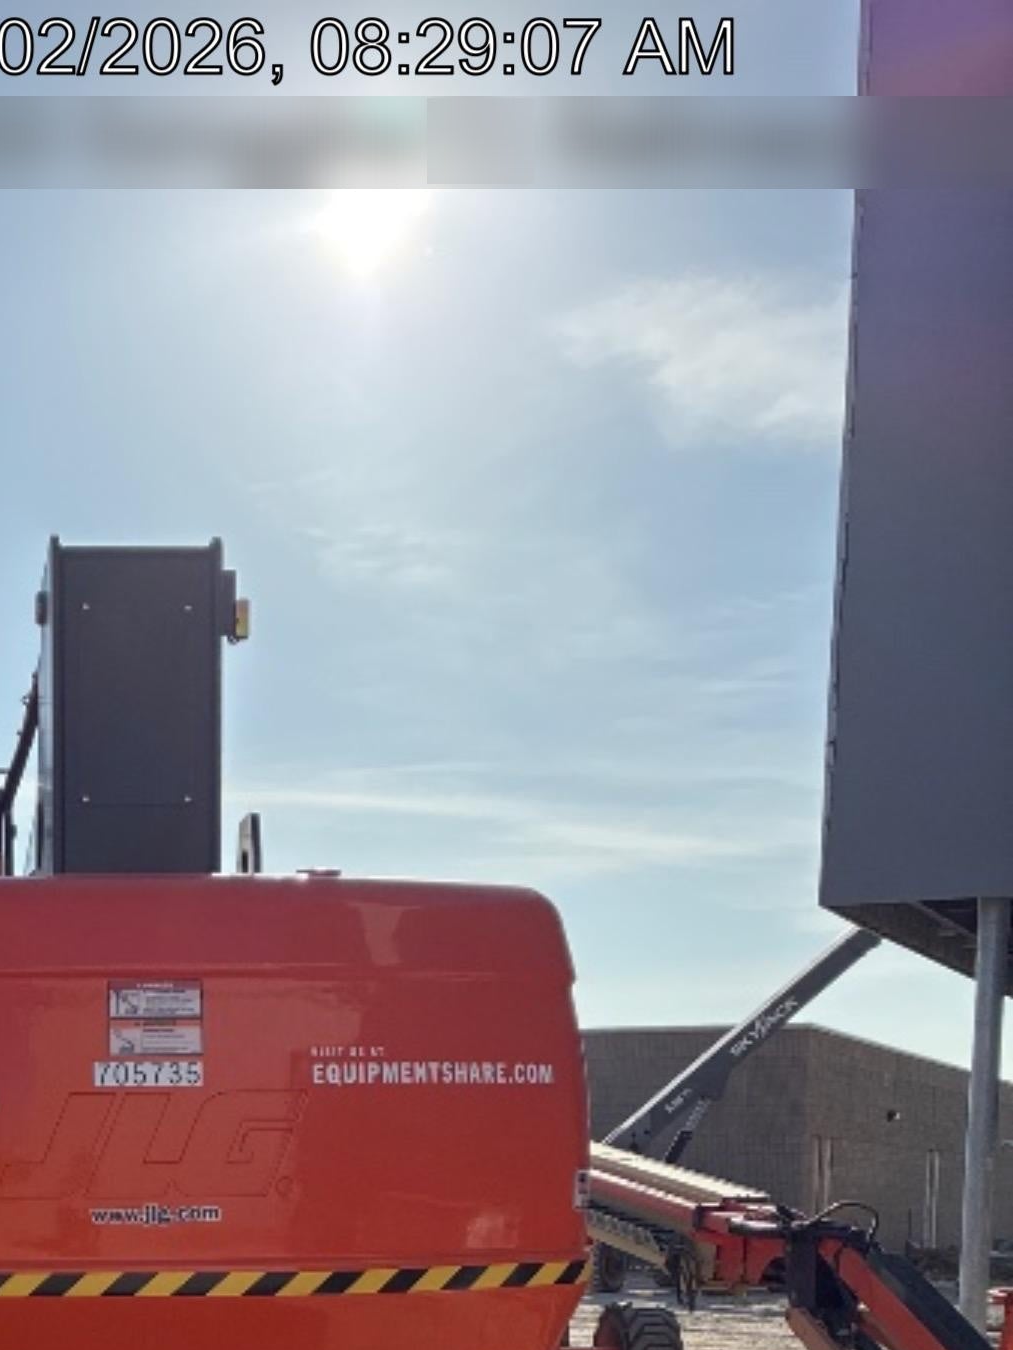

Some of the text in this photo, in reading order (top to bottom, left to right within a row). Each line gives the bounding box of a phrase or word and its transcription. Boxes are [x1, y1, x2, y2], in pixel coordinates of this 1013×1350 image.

[99, 1063, 200, 1084] 705735
[312, 1061, 554, 1085] EQUIPMENTSHARE.COM
[90, 1204, 221, 1225] www.jlg.com
